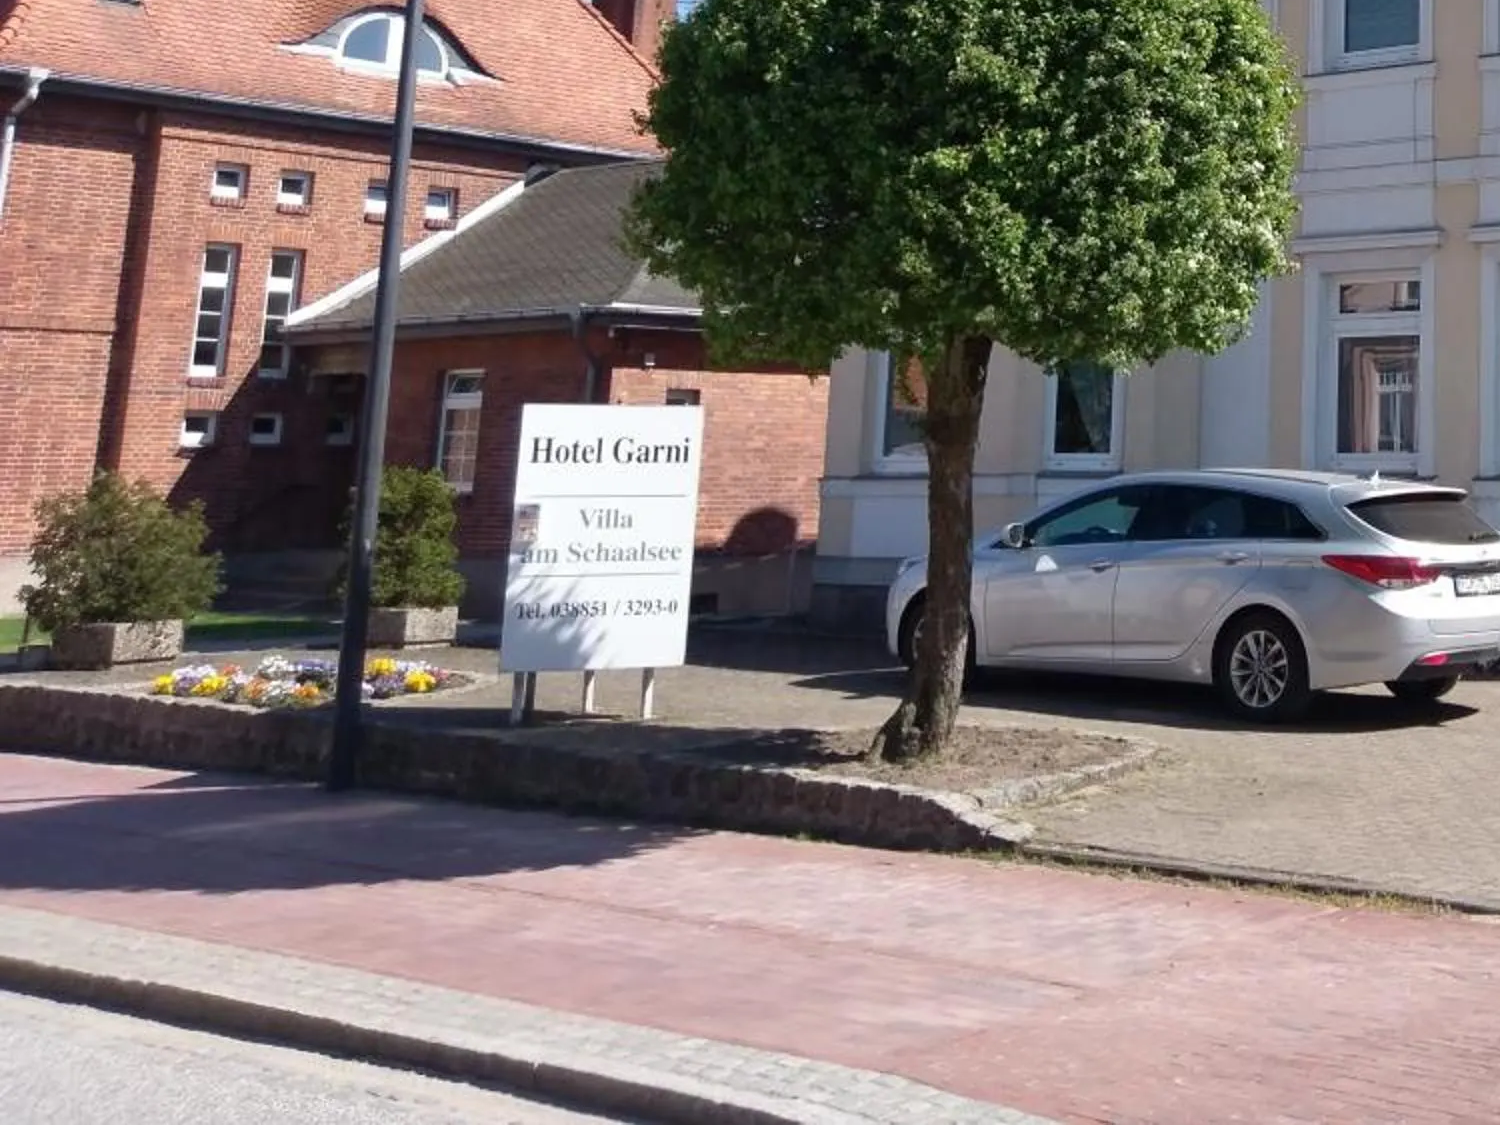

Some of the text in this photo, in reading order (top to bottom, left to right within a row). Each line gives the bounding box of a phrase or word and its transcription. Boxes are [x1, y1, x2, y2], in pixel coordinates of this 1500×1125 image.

[530, 436, 691, 464] Hotel Garni
[579, 508, 633, 529] Villa
[520, 541, 682, 564] am Schaalsee
[623, 598, 679, 616] 3293-0
